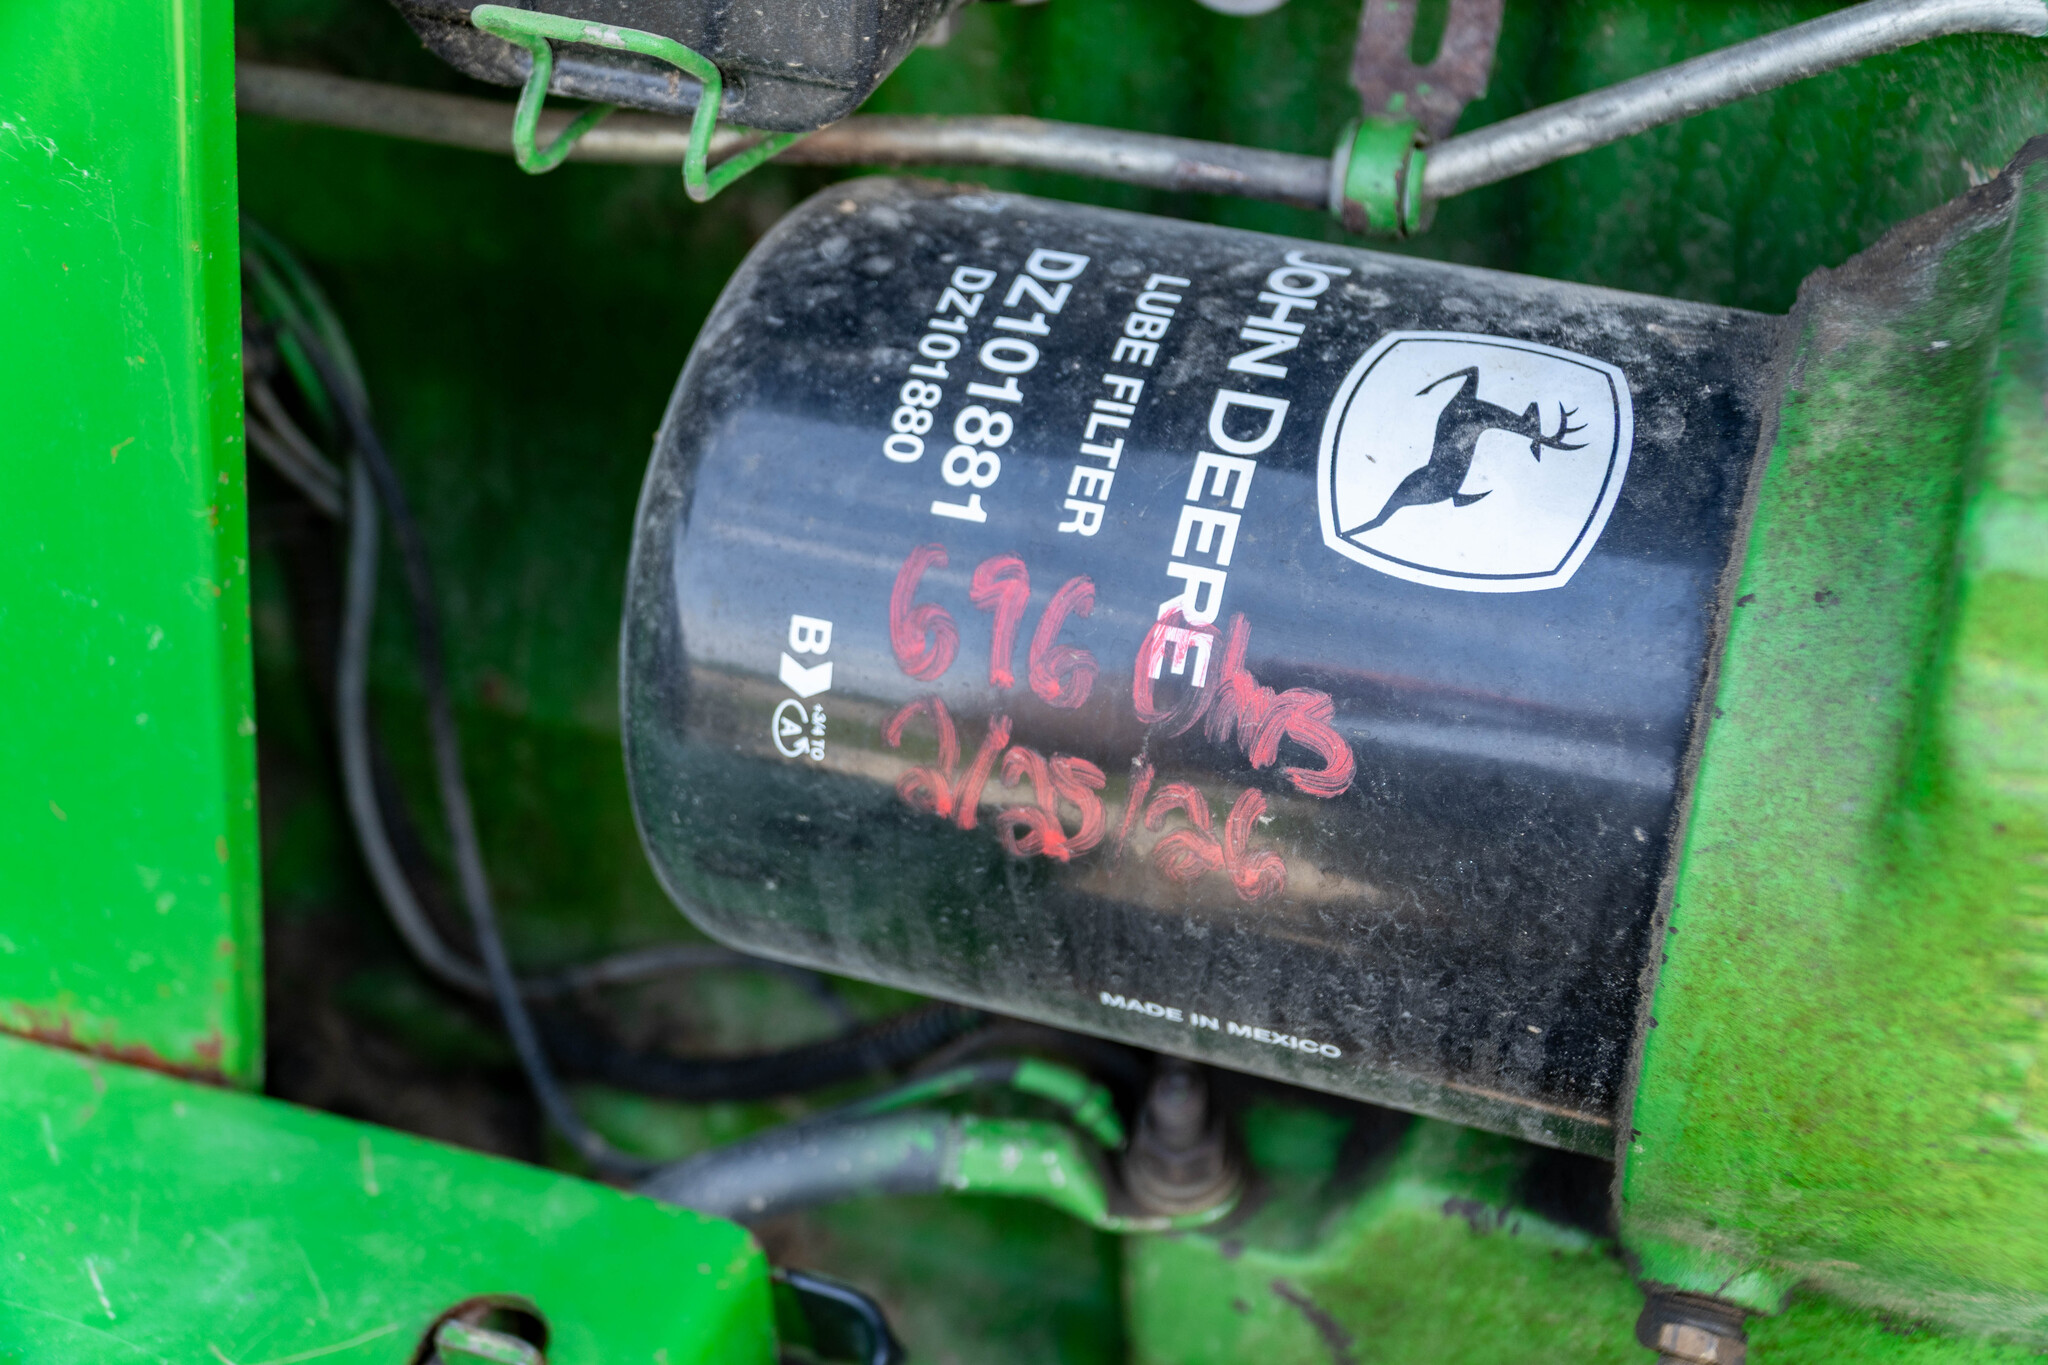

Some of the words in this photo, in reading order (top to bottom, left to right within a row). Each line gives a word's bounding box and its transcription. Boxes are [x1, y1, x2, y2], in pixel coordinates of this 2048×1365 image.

[882, 265, 997, 463] DZ101880
[930, 248, 1090, 523] DZ101881
[1111, 272, 1191, 367] LUBE
[1226, 249, 1352, 379] JOHN
[1057, 373, 1145, 537] FILTER
[1148, 388, 1291, 688] DEERE
[788, 614, 834, 655] B
[1100, 991, 1184, 1023] MADE
[1189, 1012, 1220, 1031] IN
[1226, 1021, 1342, 1059] MEXICO
